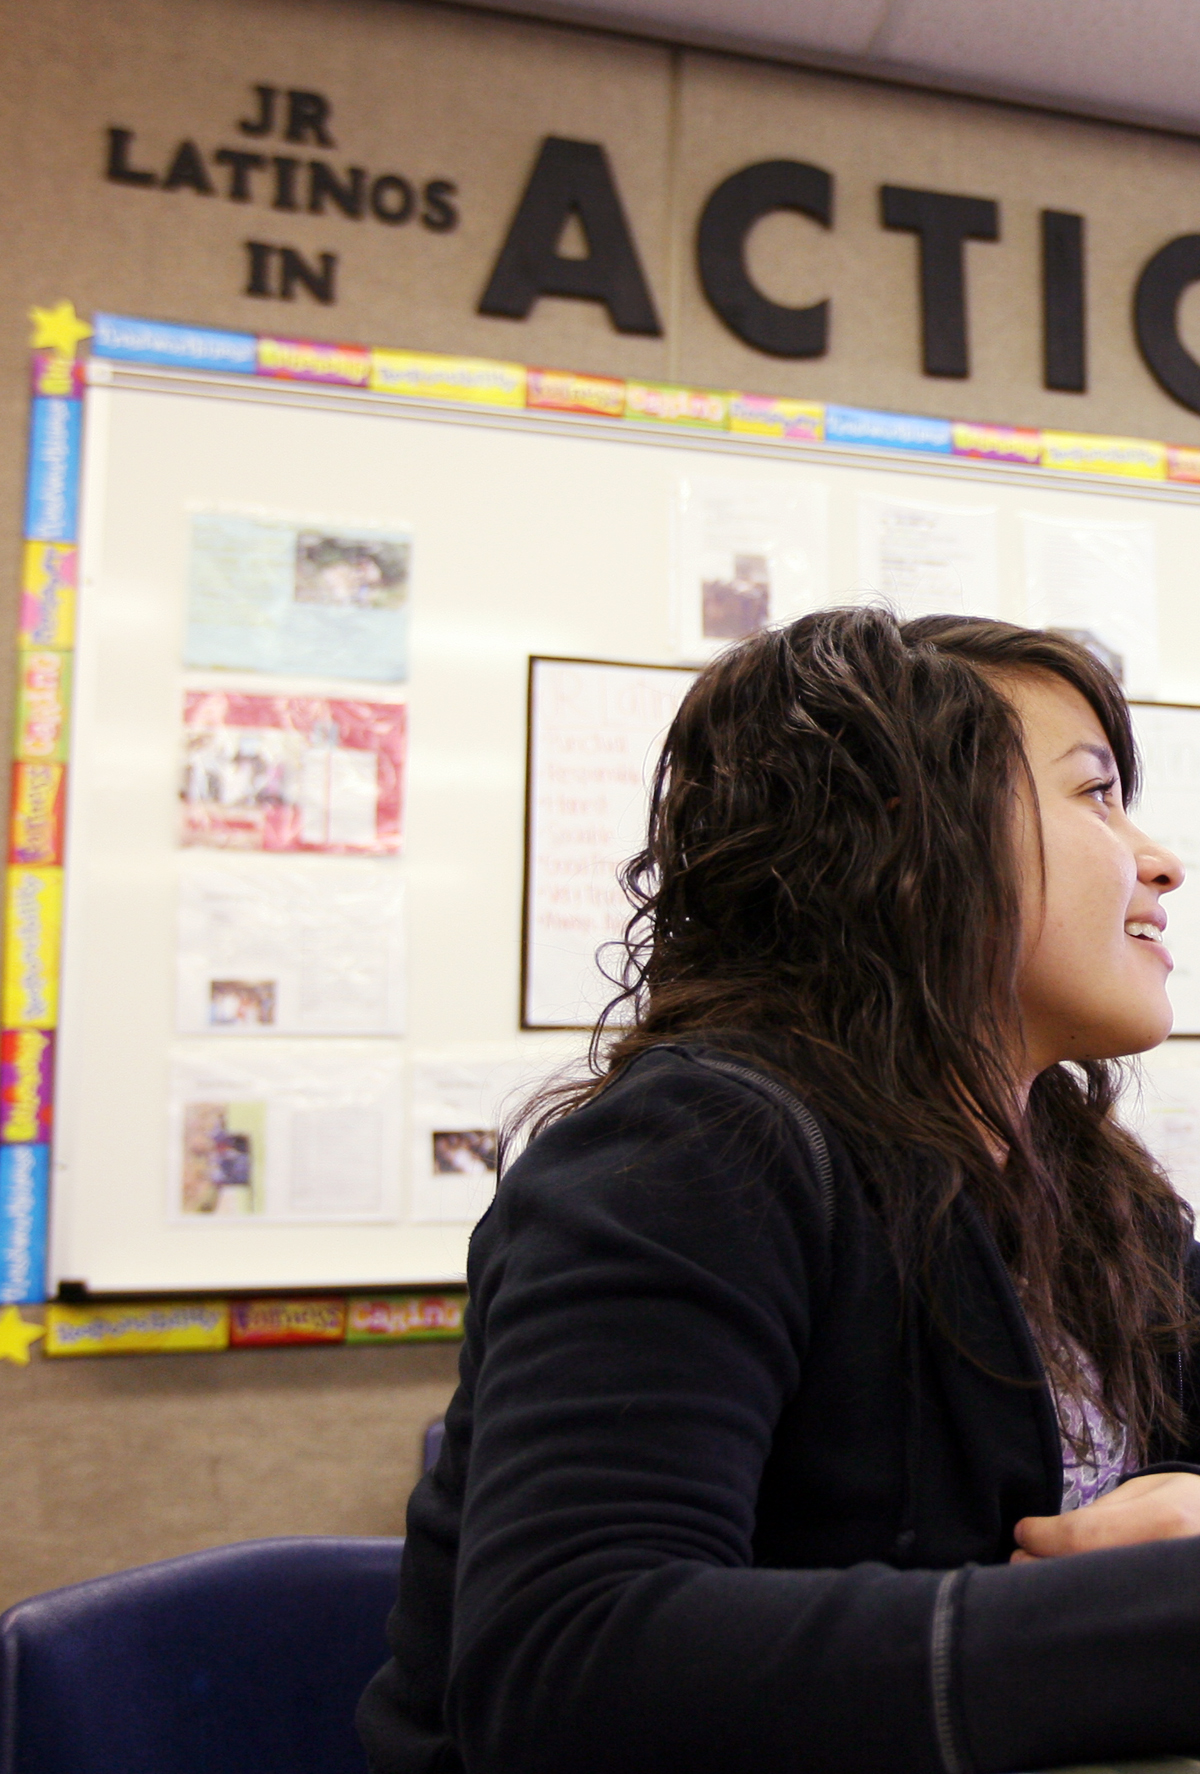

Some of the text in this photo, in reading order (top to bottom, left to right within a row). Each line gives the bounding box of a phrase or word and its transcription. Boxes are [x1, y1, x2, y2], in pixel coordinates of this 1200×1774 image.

[239, 84, 336, 149] JR
[104, 125, 460, 232] LATINOS
[245, 240, 338, 305] IN
